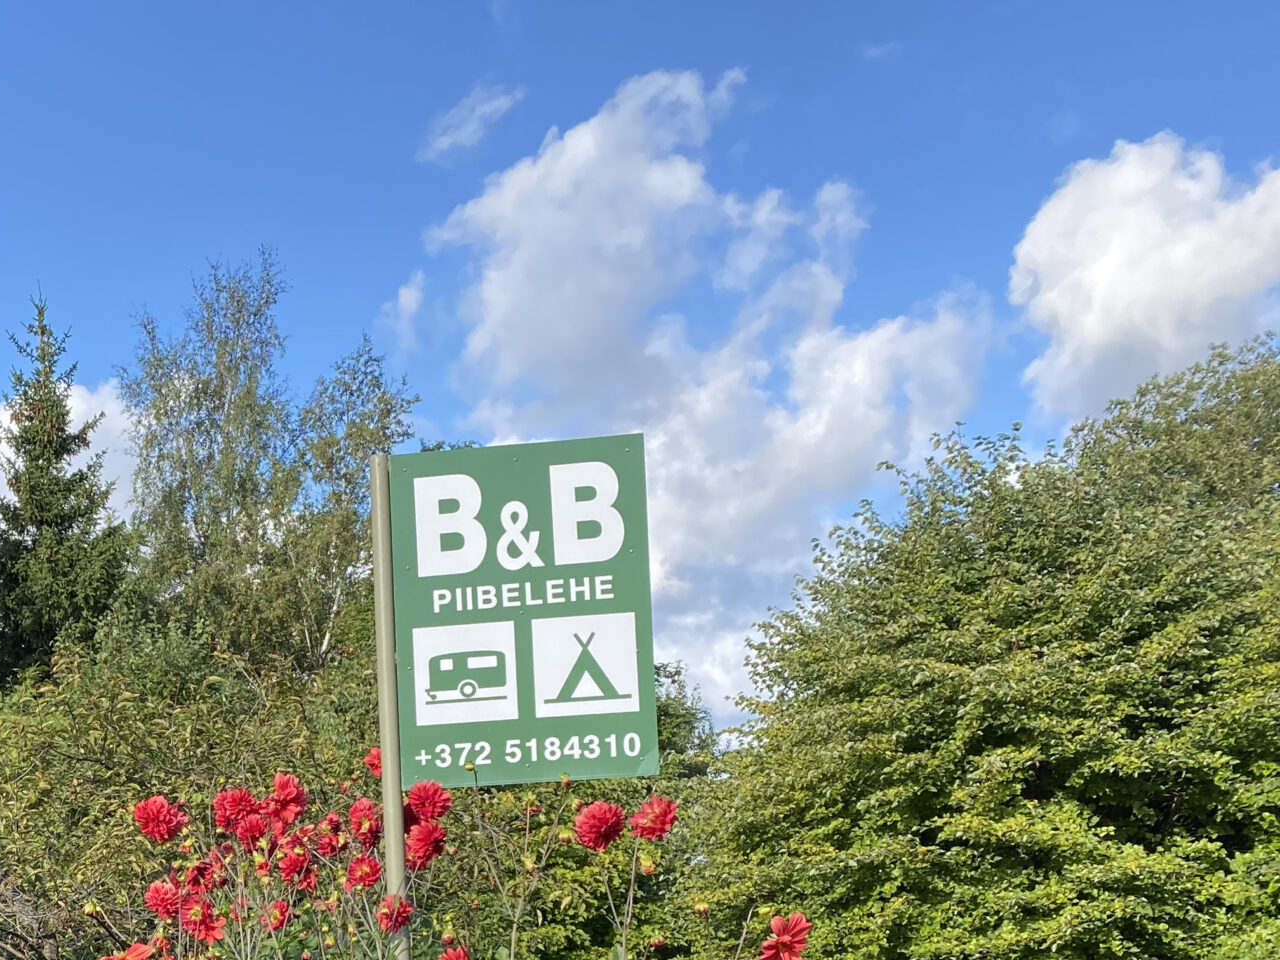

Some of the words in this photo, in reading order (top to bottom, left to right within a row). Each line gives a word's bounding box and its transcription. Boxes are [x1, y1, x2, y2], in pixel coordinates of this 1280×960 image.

[413, 461, 625, 578] B&B
[433, 575, 615, 613] PIIBELEHE
[415, 741, 492, 768] +372
[505, 733, 641, 763] 5184310
